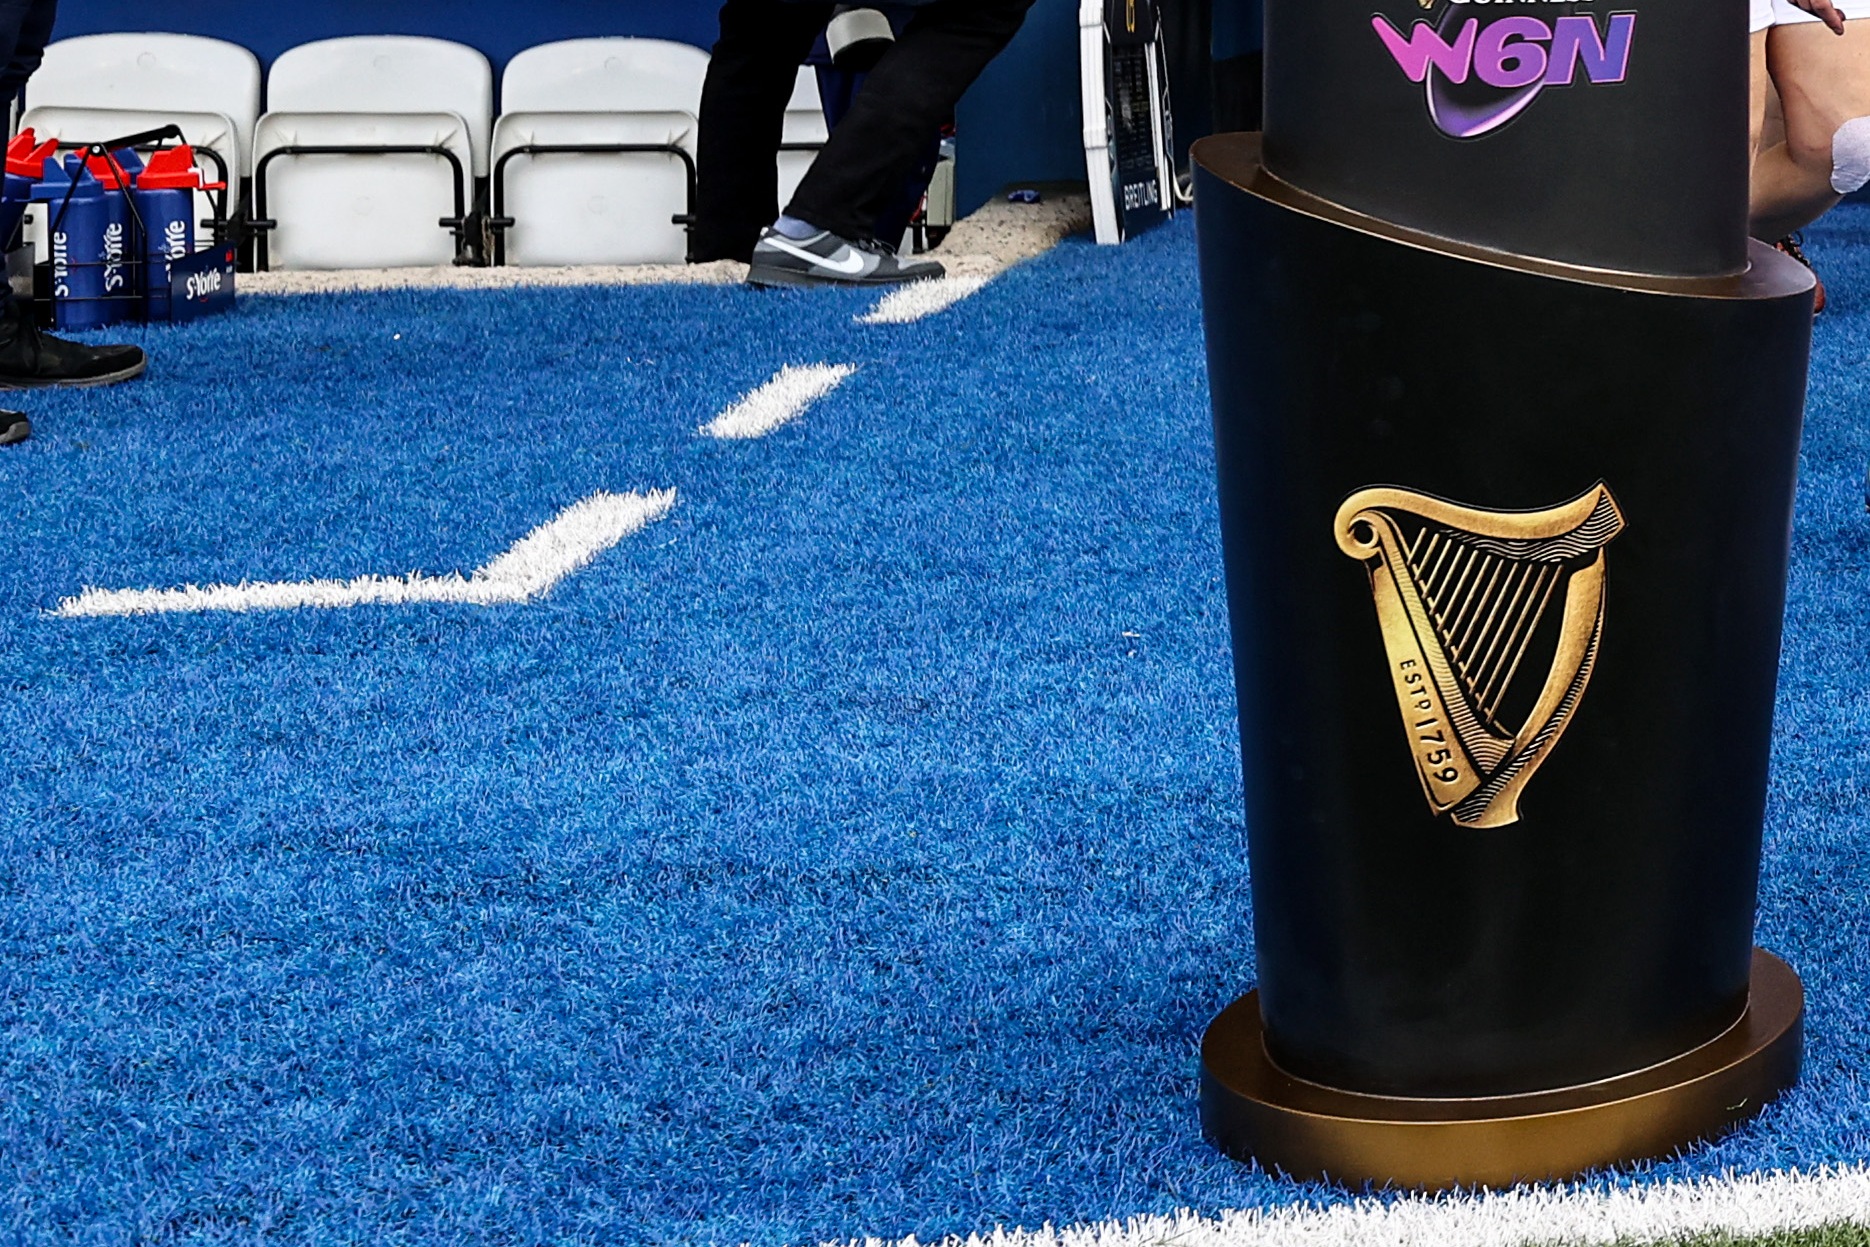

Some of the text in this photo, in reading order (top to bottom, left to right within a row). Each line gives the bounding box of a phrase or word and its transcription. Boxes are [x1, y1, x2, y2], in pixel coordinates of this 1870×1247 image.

[1371, 13, 1636, 88] W6N
[1123, 179, 1158, 211] BREITLING
[1414, 717, 1459, 783] 1759
